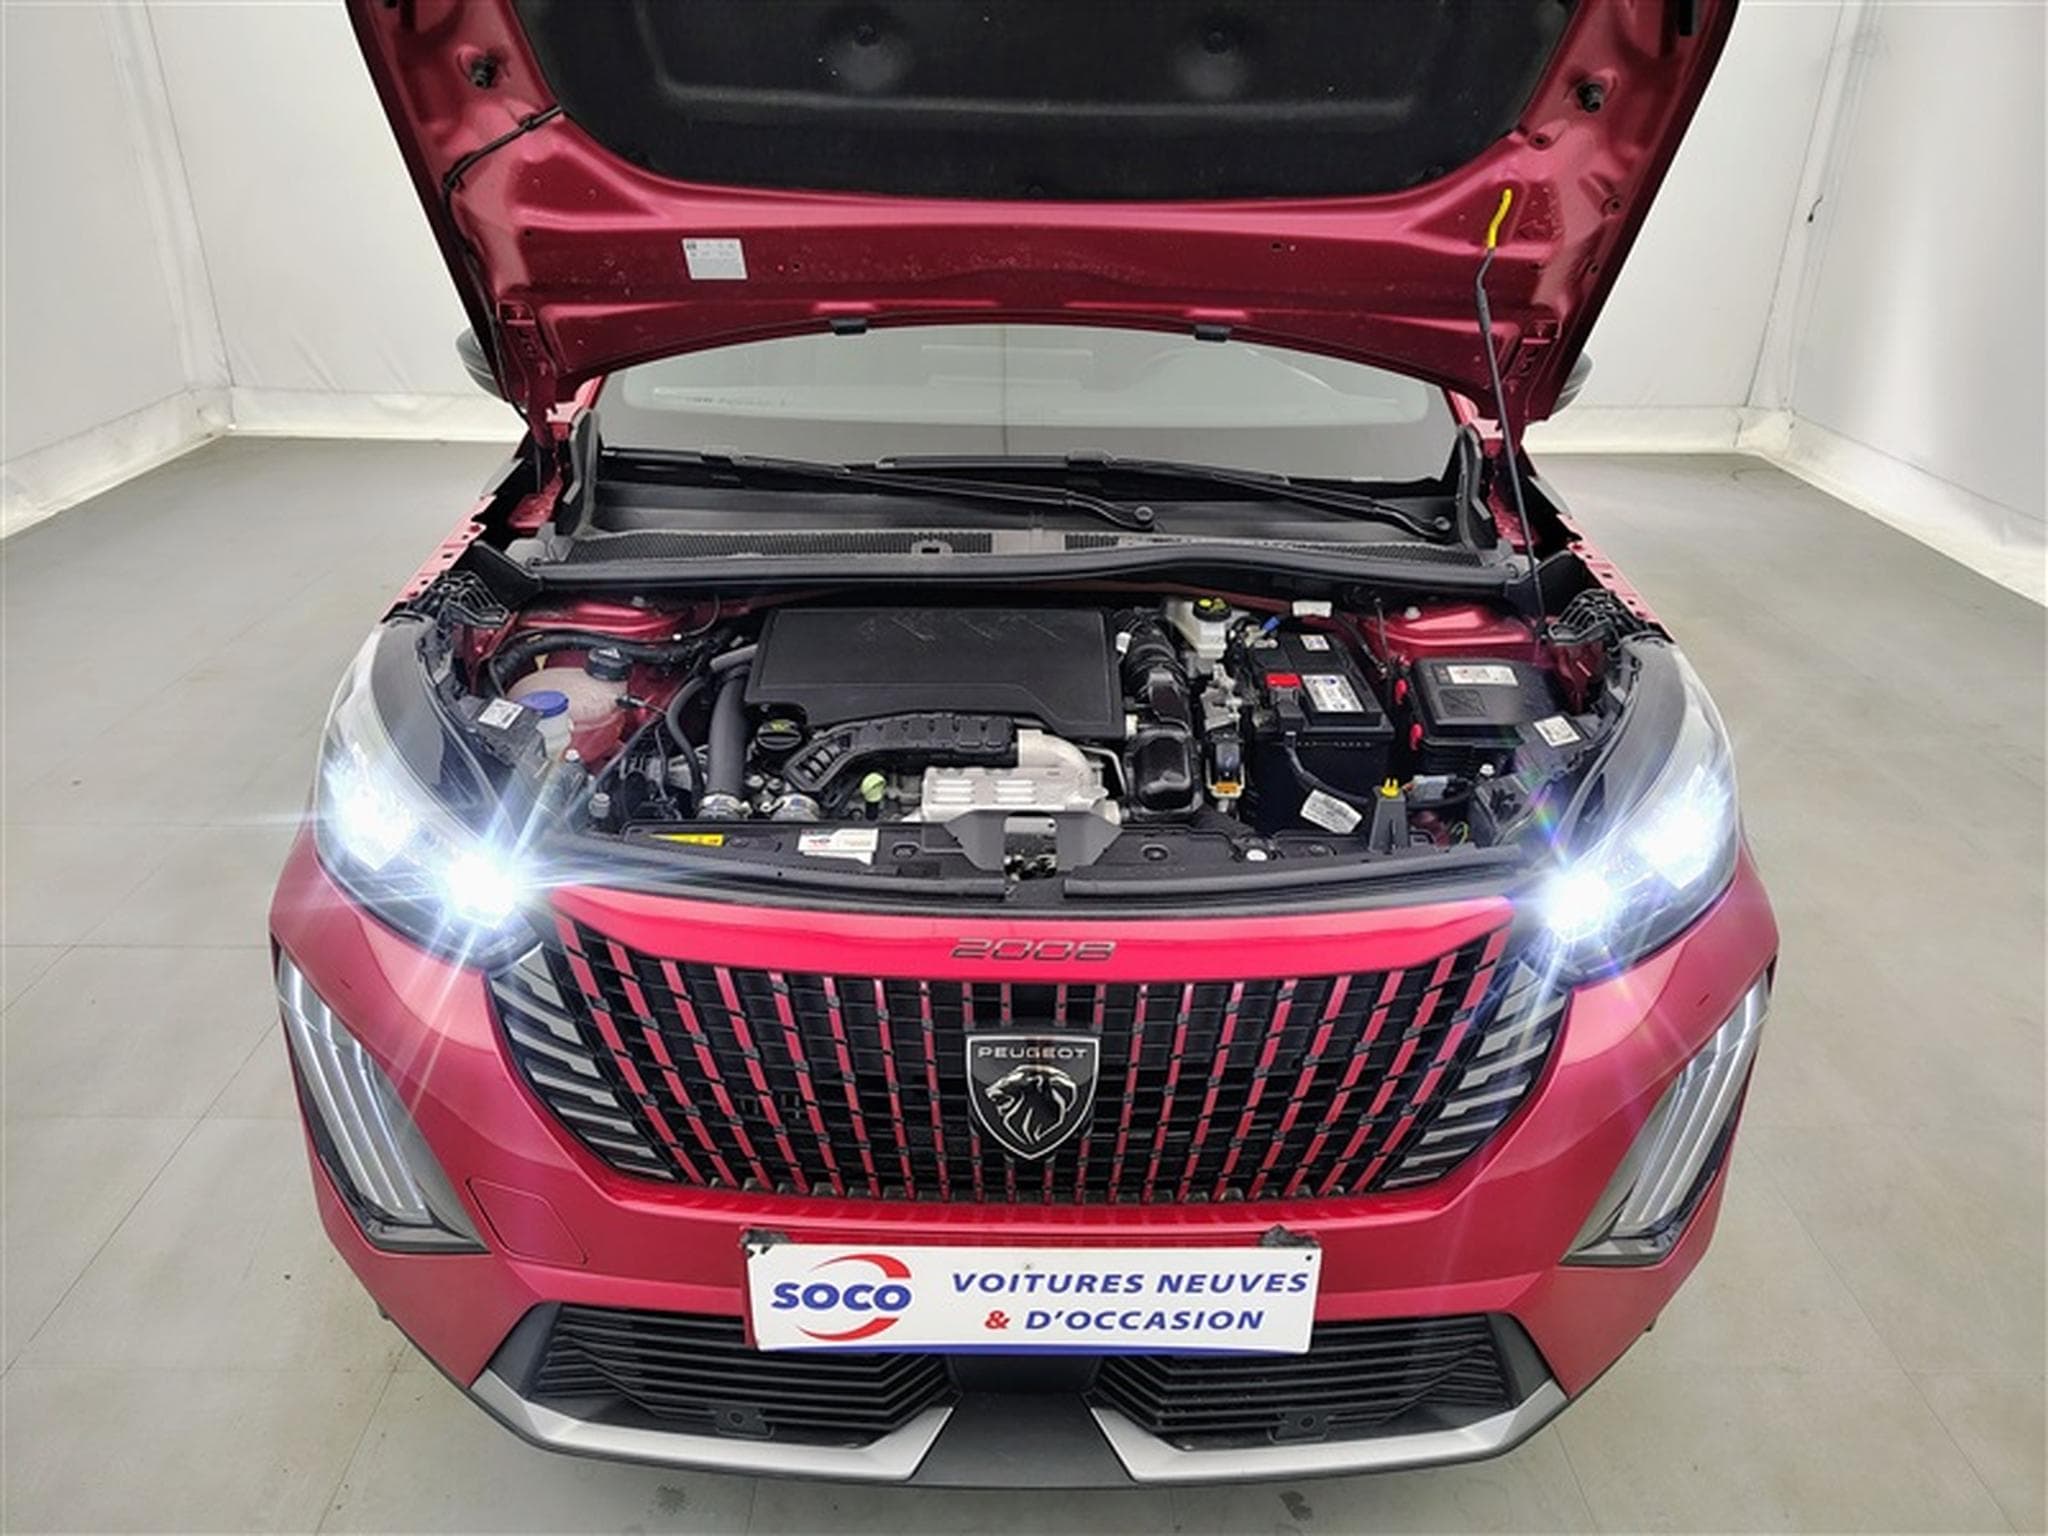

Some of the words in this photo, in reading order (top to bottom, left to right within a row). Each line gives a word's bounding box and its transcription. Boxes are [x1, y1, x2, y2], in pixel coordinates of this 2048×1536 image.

[952, 937, 1117, 962] 2008
[977, 1045, 1089, 1059] PEUGEOT
[953, 1273, 1145, 1294] VOITURES
[1156, 1273, 1309, 1294] NEUVES
[771, 1282, 912, 1312] SOCO
[985, 1310, 1011, 1330] &
[1025, 1310, 1265, 1331] D'OCCASION
